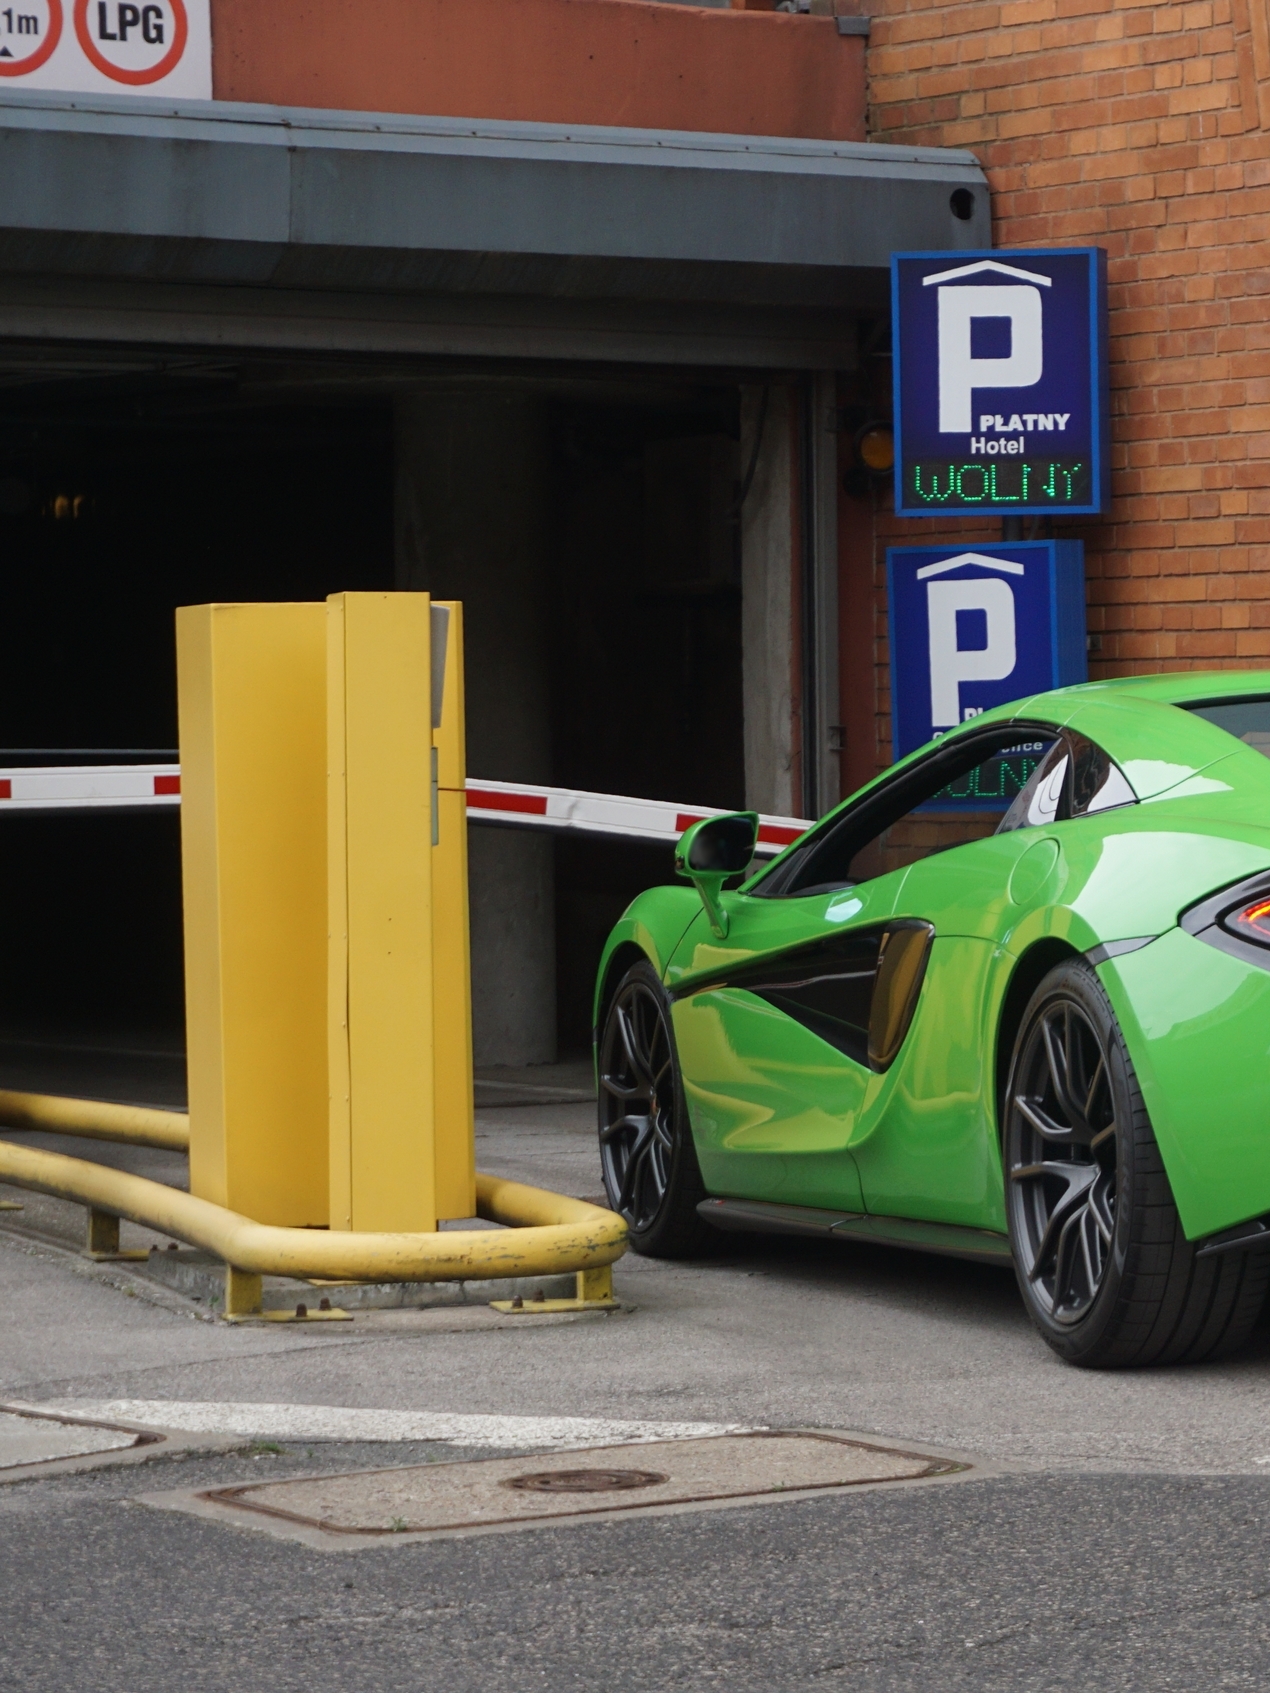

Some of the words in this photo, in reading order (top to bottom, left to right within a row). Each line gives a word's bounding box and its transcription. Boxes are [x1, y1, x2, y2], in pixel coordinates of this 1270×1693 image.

[98, 1, 165, 44] LPG
[938, 285, 1043, 433] P
[980, 413, 1071, 432] PŁATNY
[970, 436, 1025, 455] Hotel
[927, 578, 1017, 727] P
